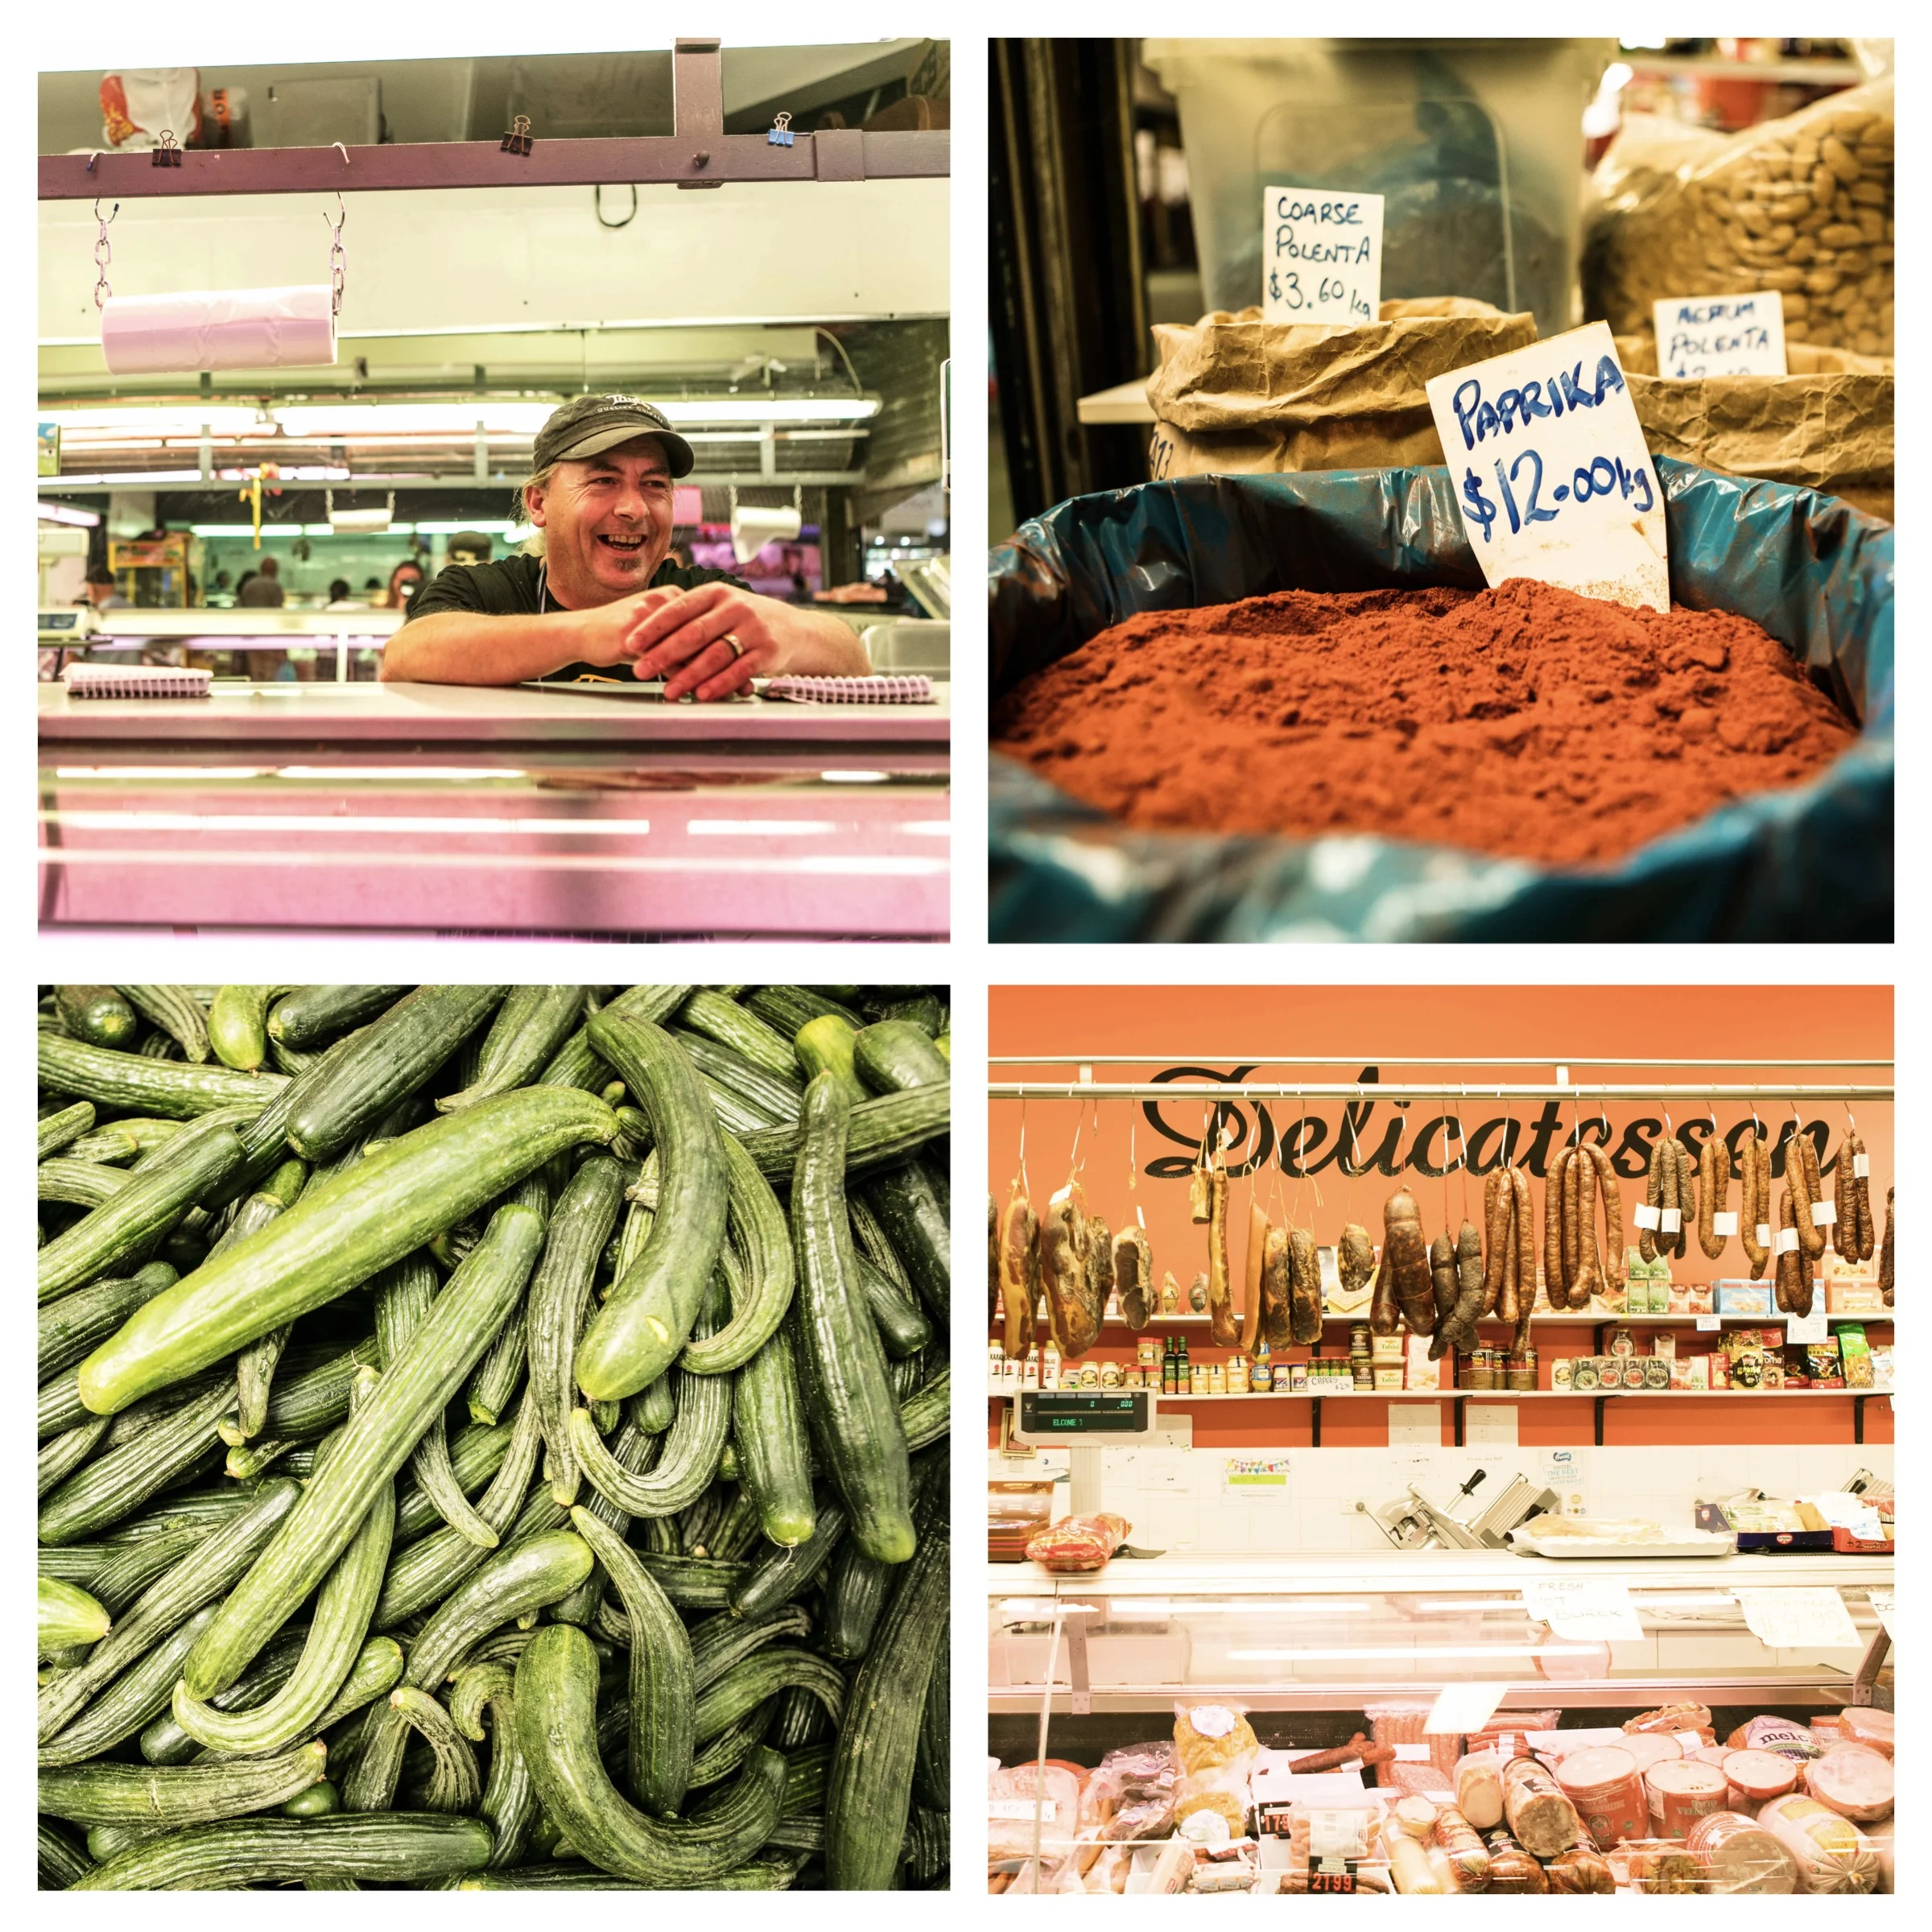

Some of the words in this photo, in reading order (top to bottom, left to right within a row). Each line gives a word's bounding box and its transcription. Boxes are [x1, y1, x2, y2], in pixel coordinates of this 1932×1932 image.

[1278, 196, 1363, 225] COARSE
[1276, 225, 1371, 264] POLENTA
[1668, 327, 1769, 361] POLENTA
[1452, 354, 1624, 451] PAPRIKA
[1142, 1066, 1843, 1179] Delicatessen
[1311, 1377, 1338, 1385] CAPERS
[1052, 1418, 1076, 1426] ELCOME
[1538, 1583, 1583, 1591] FRESH
[1555, 1610, 1623, 1620] BUREK
